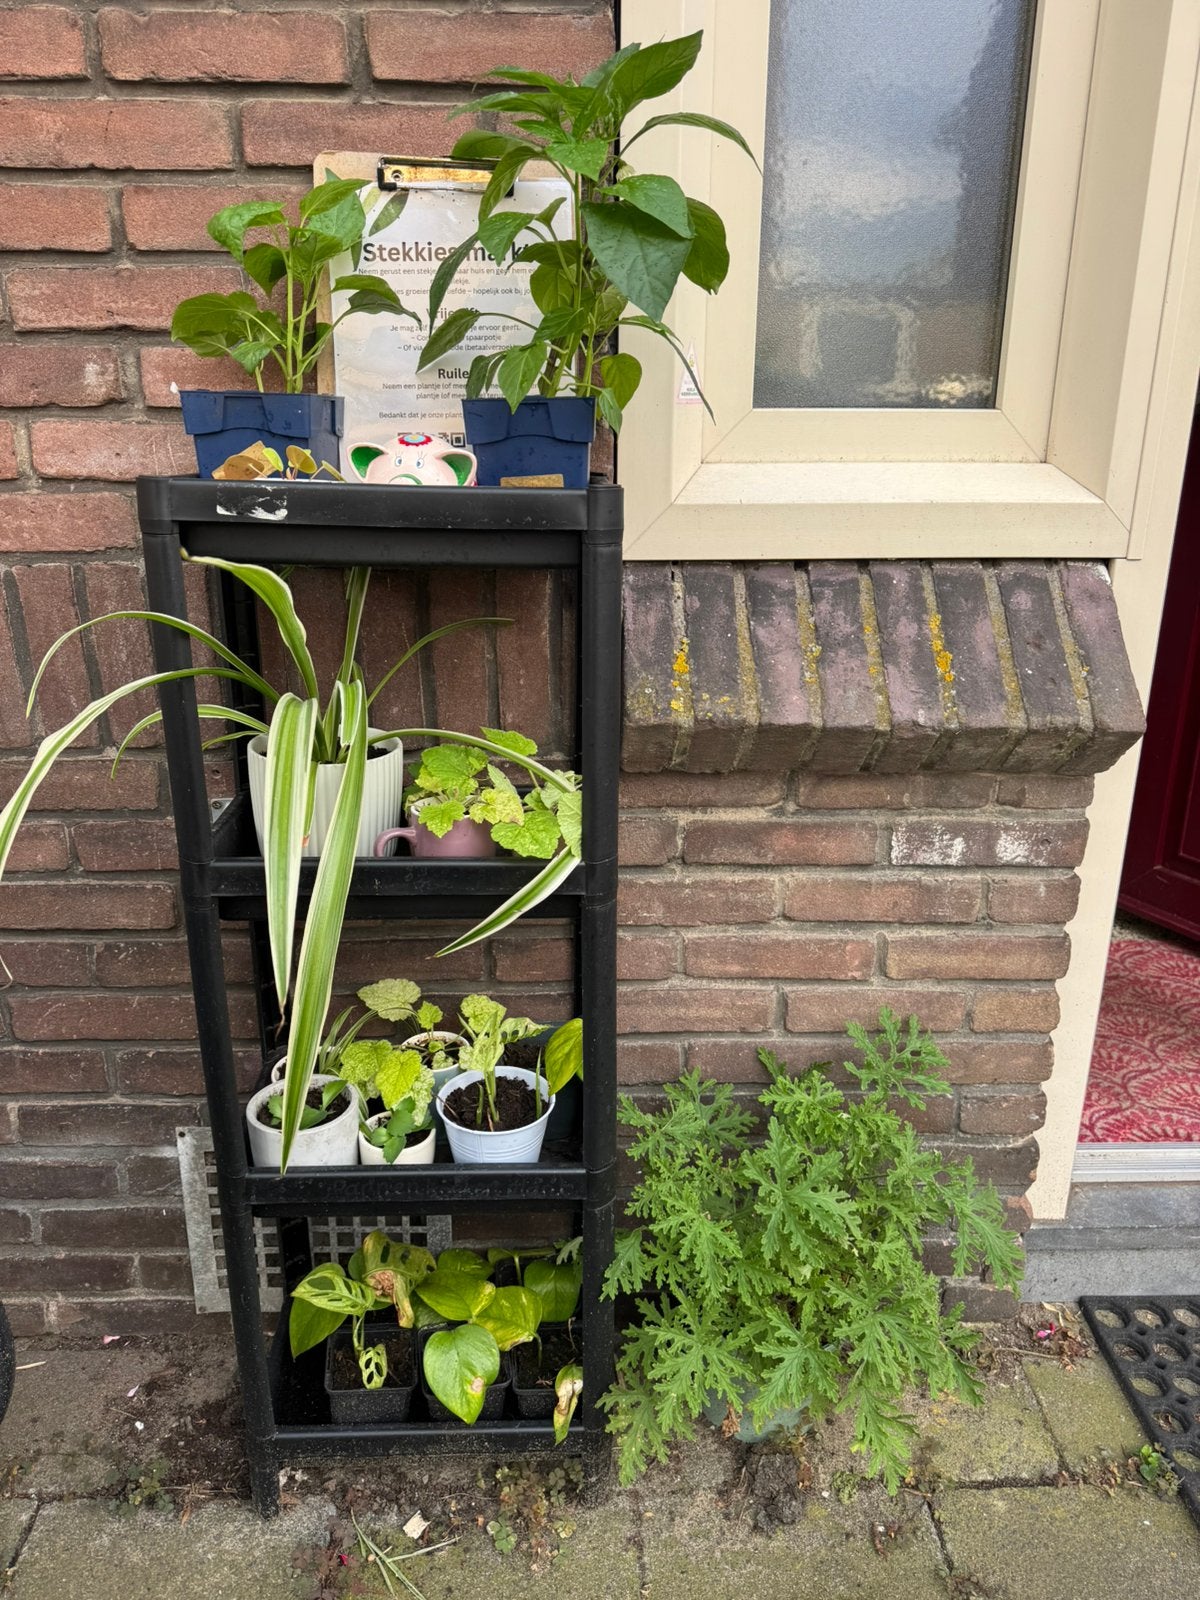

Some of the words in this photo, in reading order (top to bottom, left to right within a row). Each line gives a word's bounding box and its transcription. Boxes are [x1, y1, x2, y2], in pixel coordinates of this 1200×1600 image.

[467, 241, 529, 262] mak
[473, 287, 500, 296] hopelijk
[500, 287, 513, 295] ook
[400, 325, 415, 333] mag
[466, 334, 502, 342] spaarpotje
[438, 367, 470, 379] Ruile
[417, 382, 441, 391] plantje
[416, 392, 439, 401] plantje
[378, 411, 406, 419] Bedankt
[407, 411, 419, 419] dat
[420, 411, 427, 420] je
[445, 411, 463, 420] plant
